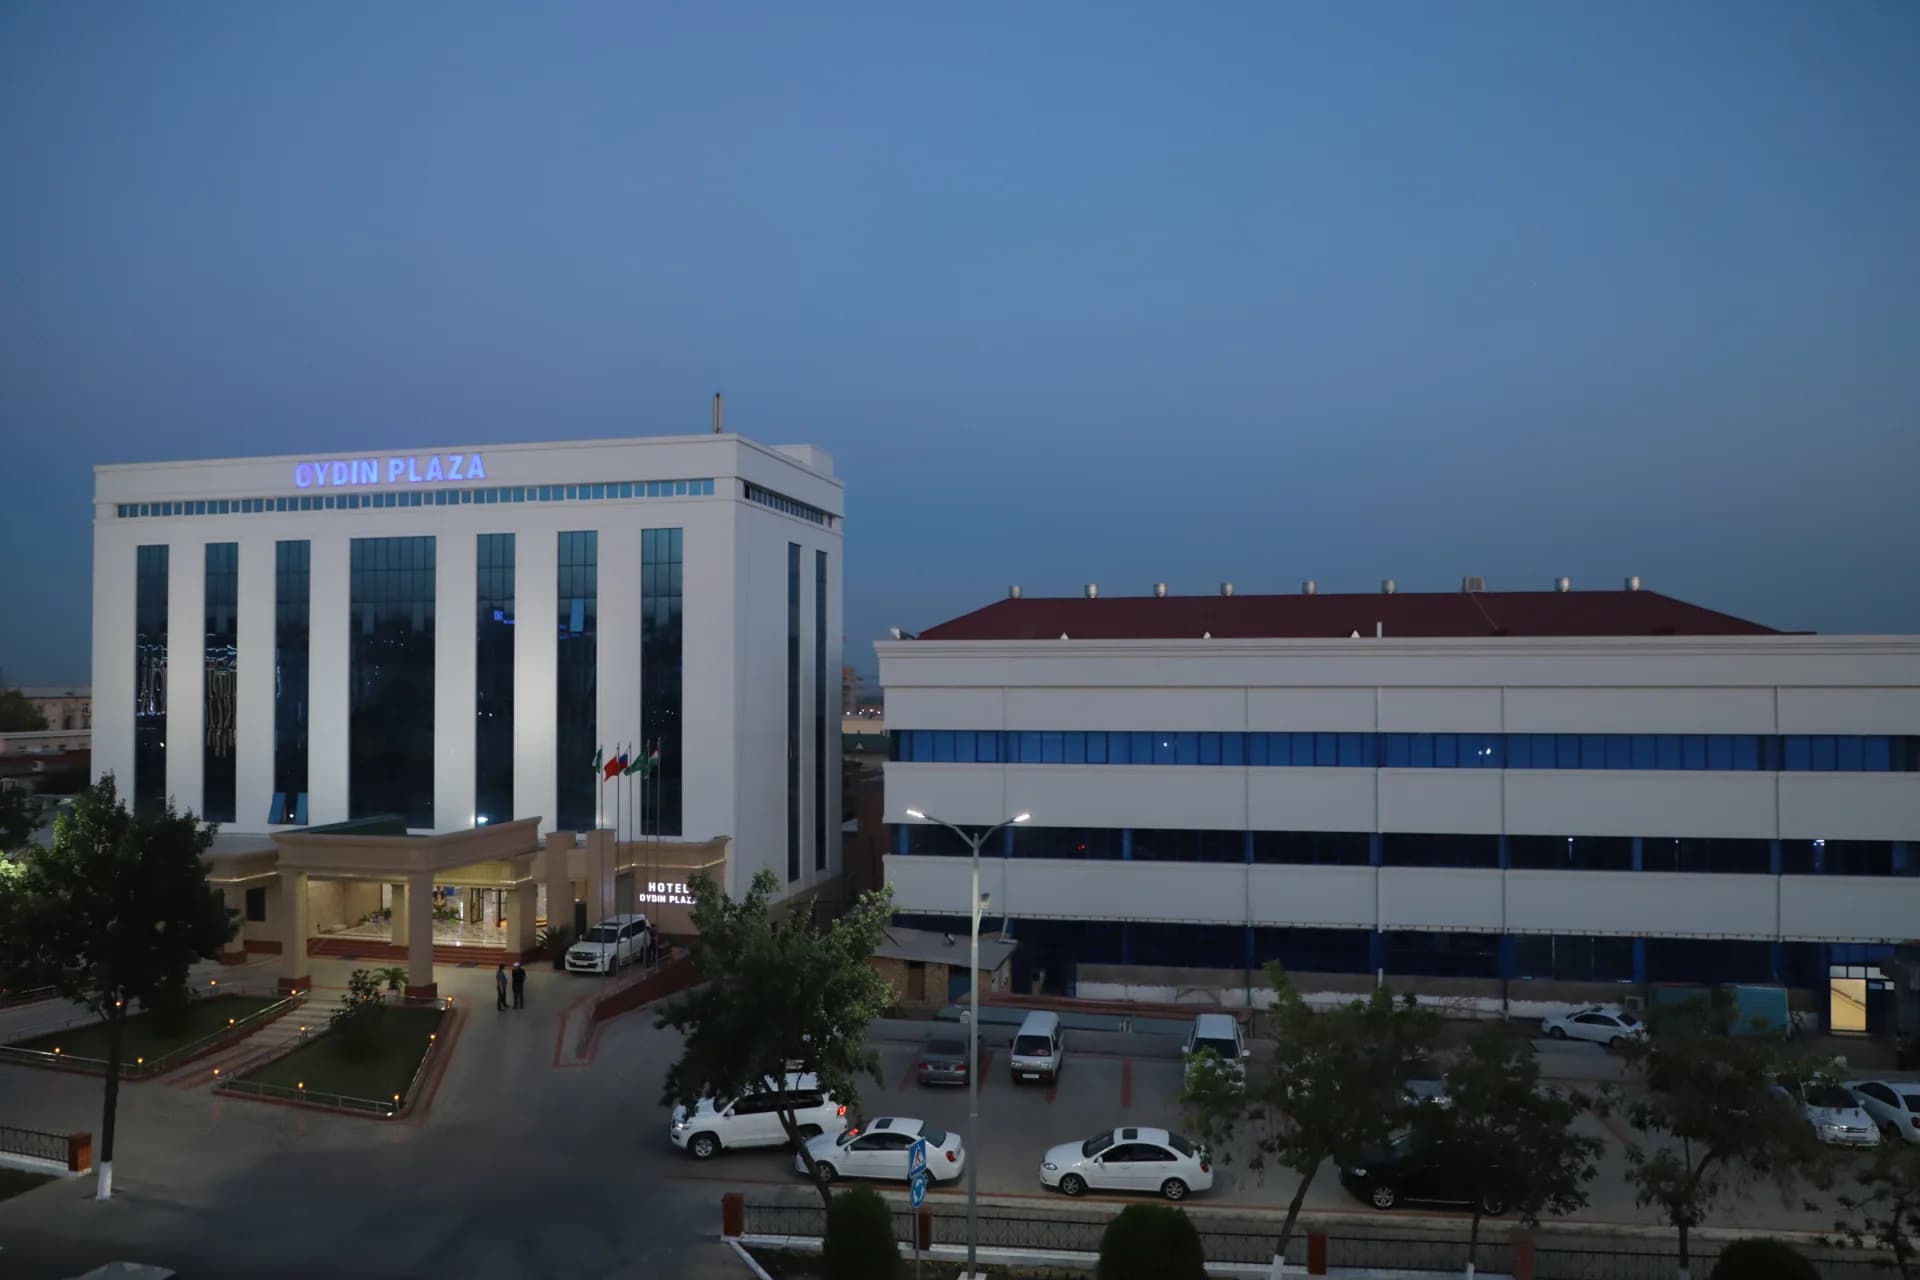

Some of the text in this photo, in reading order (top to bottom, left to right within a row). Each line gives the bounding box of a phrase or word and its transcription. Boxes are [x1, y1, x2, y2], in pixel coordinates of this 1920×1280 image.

[295, 453, 486, 488] OYDIN PLAZA
[648, 882, 689, 894] HOTEL
[640, 894, 667, 903] OYDIN
